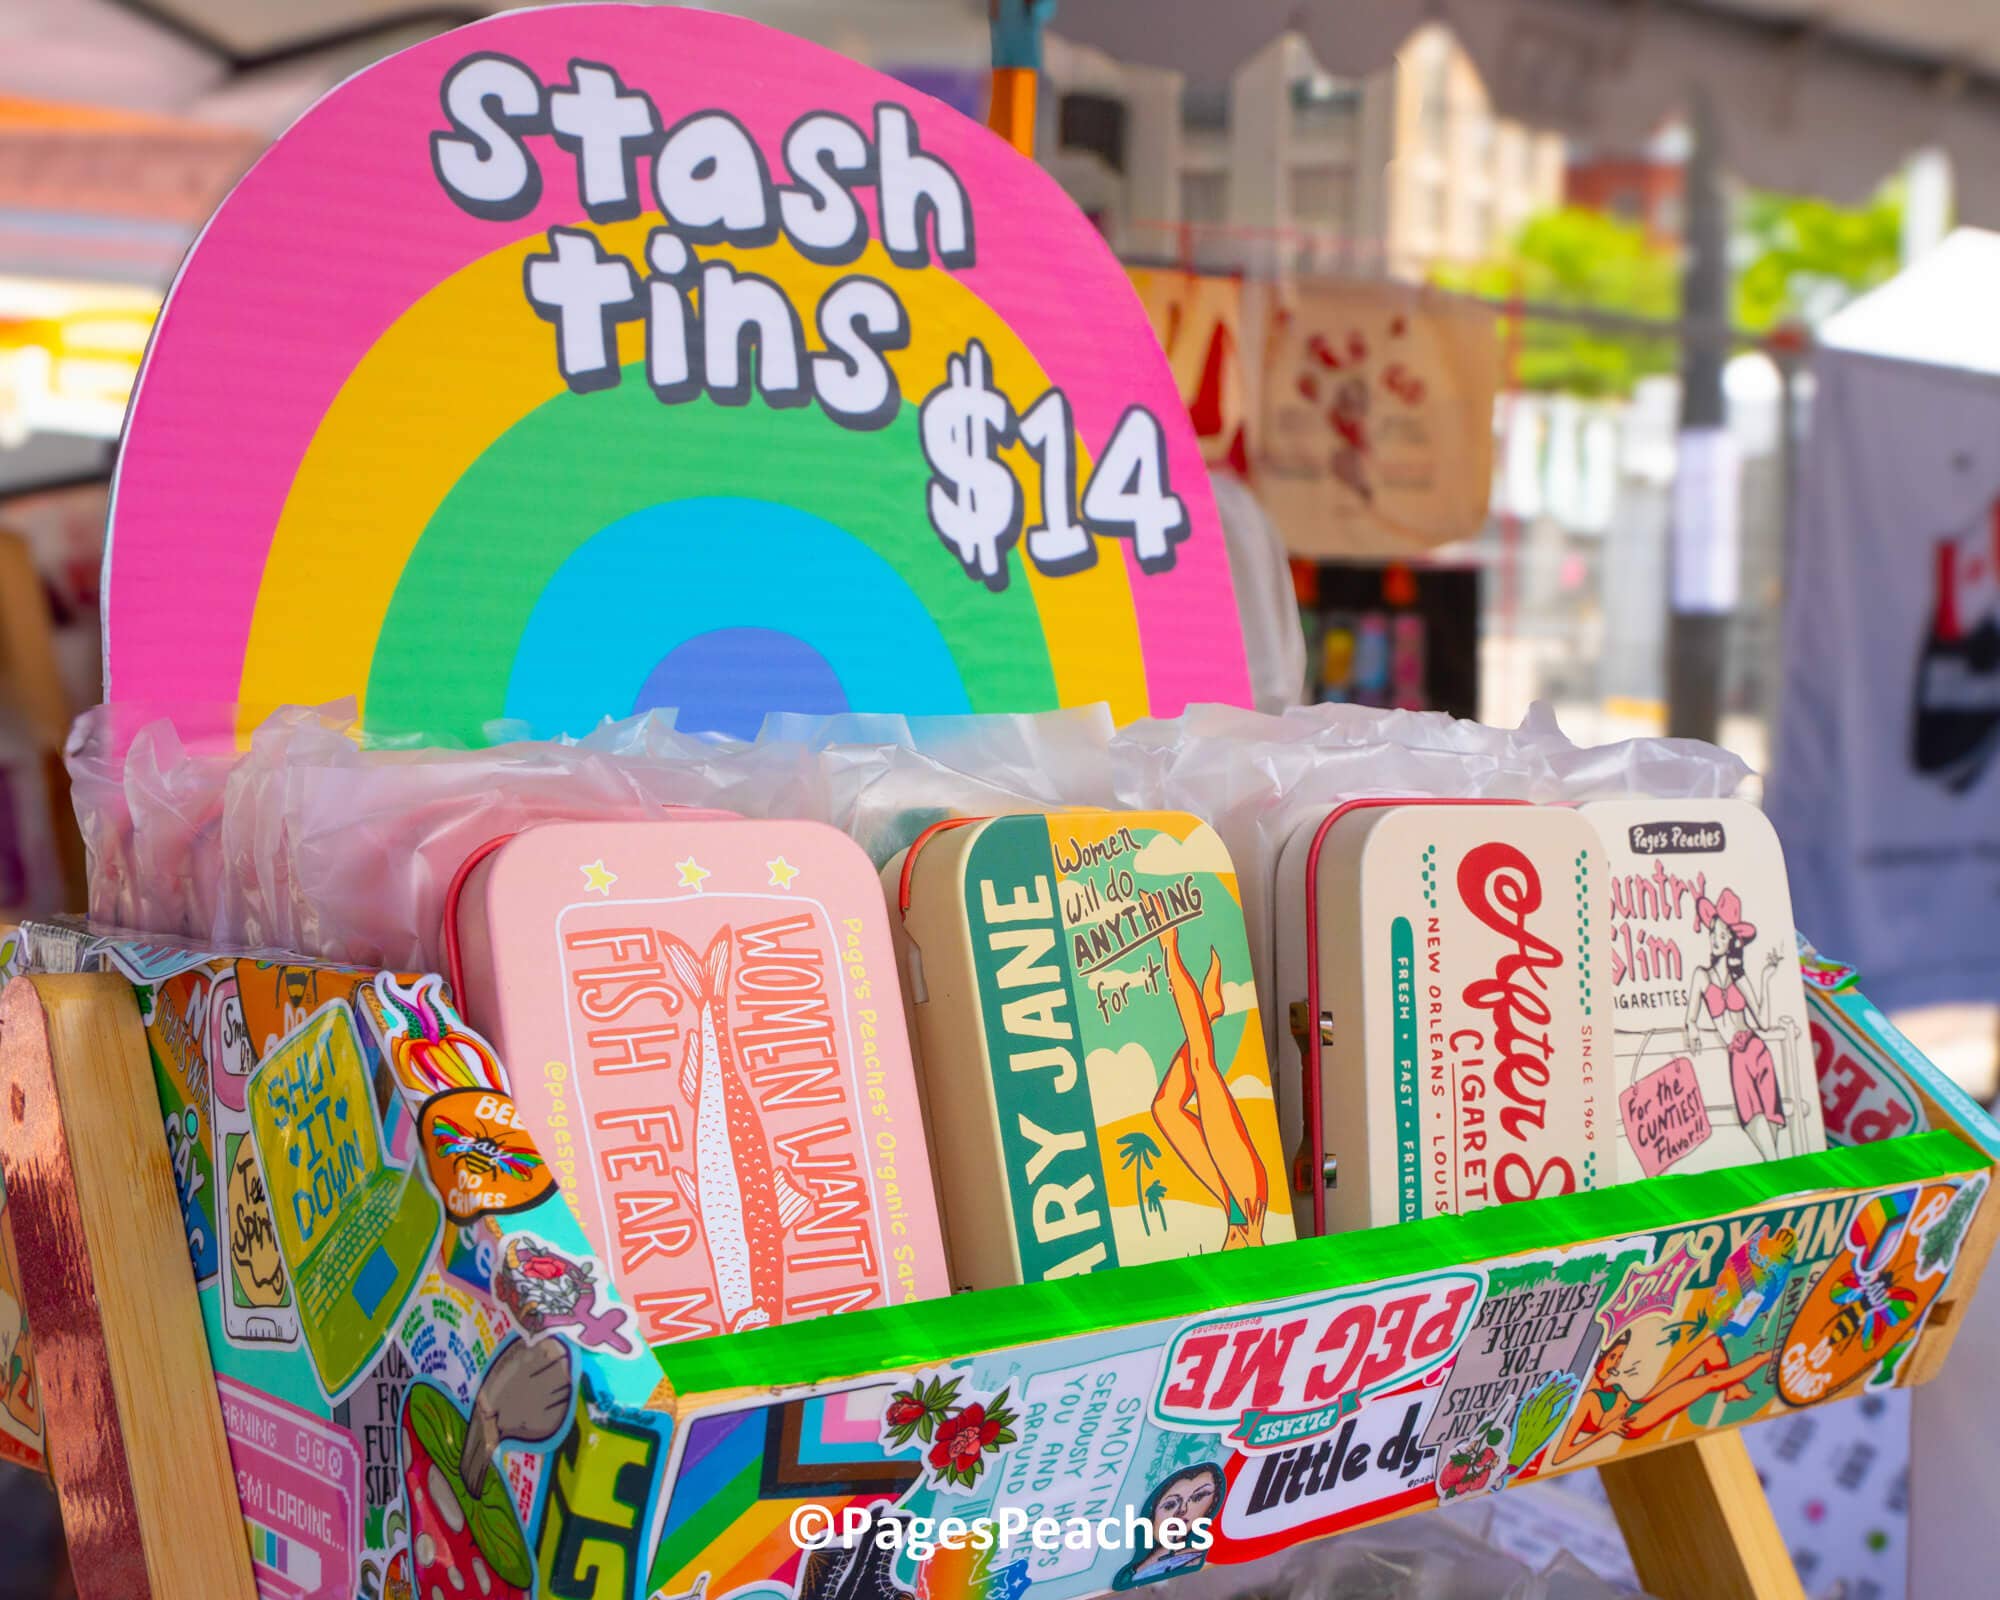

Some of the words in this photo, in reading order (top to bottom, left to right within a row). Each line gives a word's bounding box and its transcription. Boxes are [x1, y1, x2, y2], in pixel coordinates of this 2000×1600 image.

[524, 226, 910, 430] tins
[920, 339, 1190, 591] $14
[1054, 827, 1141, 874] Women
[1633, 826, 1668, 853] Page's
[1671, 826, 1721, 849] Peaches
[1074, 875, 1203, 970] ANYTHING
[1426, 917, 1441, 974] NEW
[564, 927, 680, 1076] FISH
[734, 912, 847, 1112] WOMEN
[979, 874, 1079, 1095] JANE
[1096, 980, 1131, 1024] for
[1141, 946, 1174, 993] it!
[1397, 956, 1411, 1020] FRESH
[1456, 841, 1565, 1142] After
[267, 1028, 336, 1130] SHUT
[842, 916, 872, 999] Page's
[874, 1131, 910, 1237] Organic
[1400, 1059, 1413, 1107] FAST
[1427, 985, 1446, 1098] ORLEANS
[1580, 1025, 1594, 1085] SINCE
[297, 1096, 334, 1171] IT
[1583, 1096, 1595, 1141] 1969
[1628, 1097, 1652, 1123] For
[1656, 1074, 1684, 1107] the
[1637, 1087, 1701, 1147] CUNTIEST
[292, 1128, 365, 1242] DOWN
[594, 1105, 698, 1276] FEAR
[774, 1116, 879, 1276] WANT
[1163, 1318, 1309, 1411] ME
[1303, 1284, 1477, 1402] PEG
[1481, 1311, 1578, 1355] FUTURE
[1498, 1343, 1547, 1378] FOR
[1053, 1372, 1089, 1425] YOU
[1254, 1407, 1337, 1444] PLEASE
[1006, 1401, 1048, 1495] AROUND
[1031, 1442, 1065, 1492] AND
[1078, 1396, 1141, 1530] SMOKIN
[1244, 1418, 1368, 1517] little
[1376, 1401, 1436, 1479] dy
